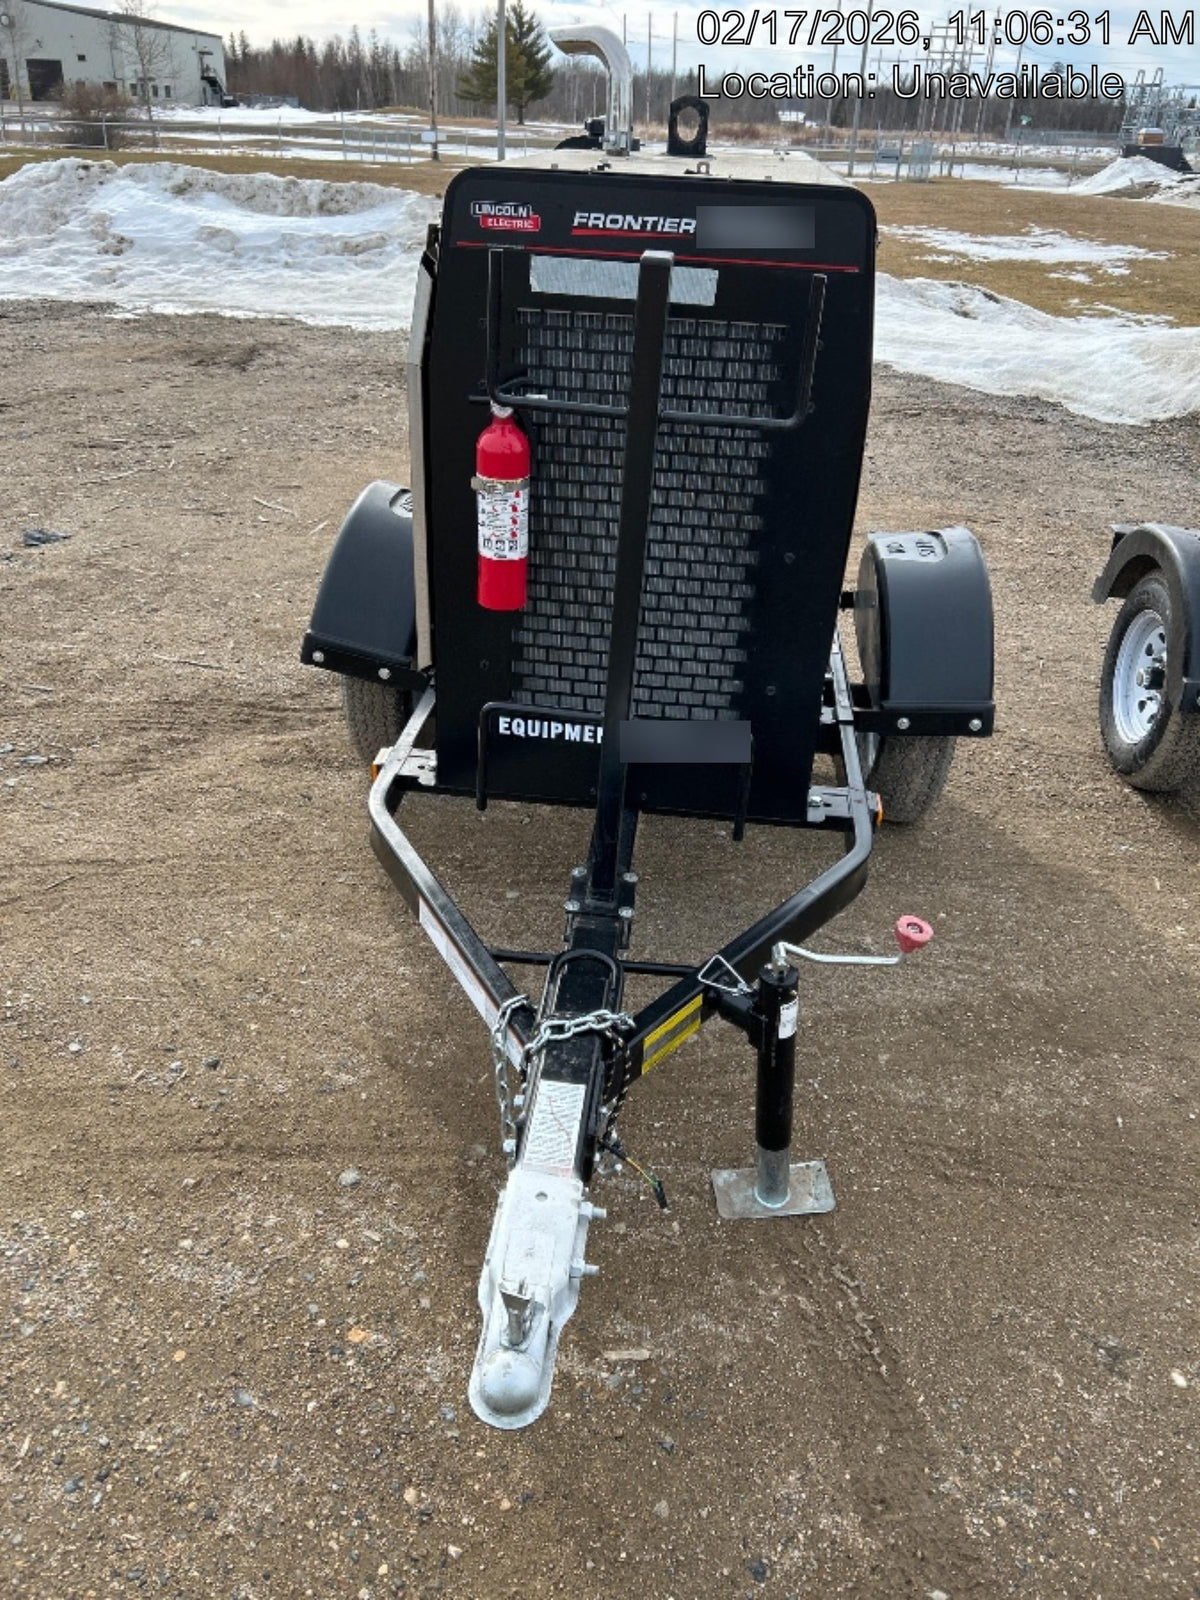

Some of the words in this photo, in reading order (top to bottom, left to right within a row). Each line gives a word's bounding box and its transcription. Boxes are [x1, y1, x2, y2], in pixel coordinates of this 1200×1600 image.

[475, 203, 529, 217] LINCOLN
[487, 218, 535, 229] ELECTRIC
[572, 211, 697, 234] FRONTIER
